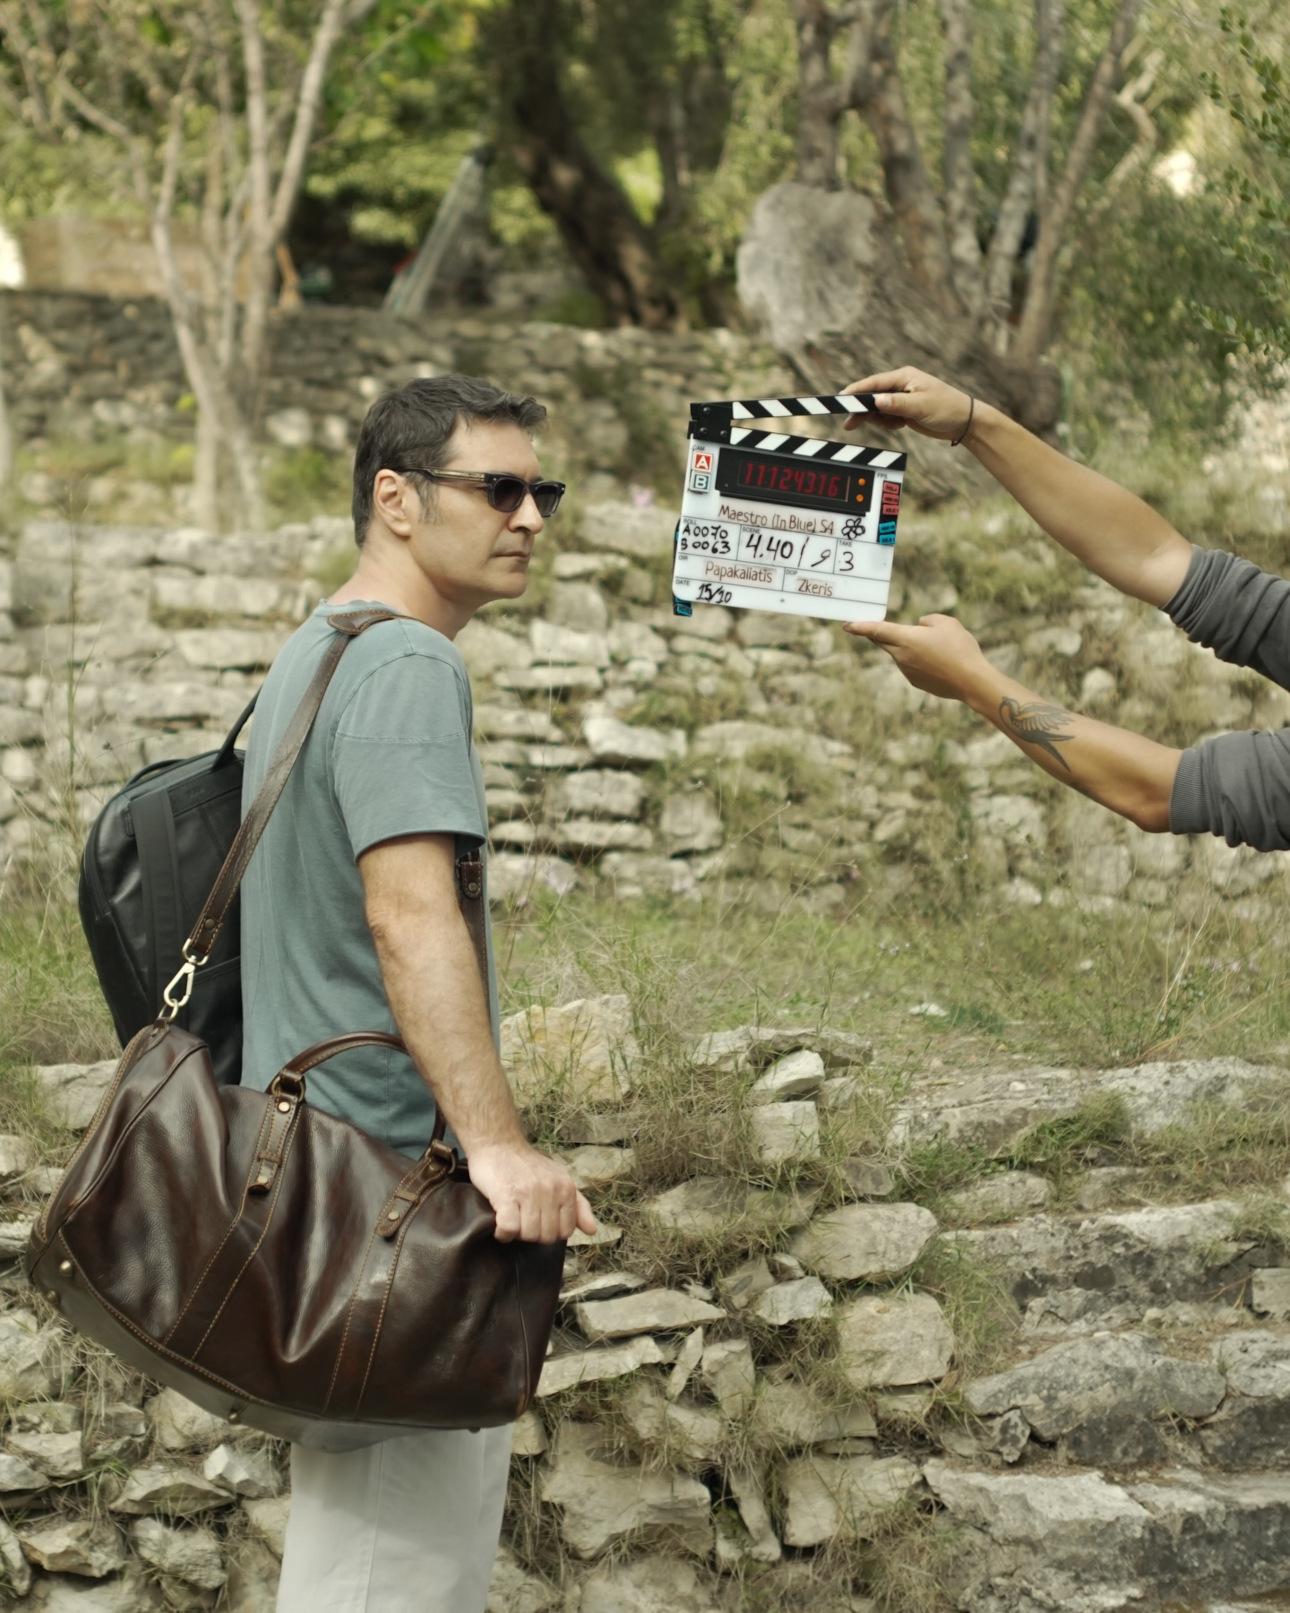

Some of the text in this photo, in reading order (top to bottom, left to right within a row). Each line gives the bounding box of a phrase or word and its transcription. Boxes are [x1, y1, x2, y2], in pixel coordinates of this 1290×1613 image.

[695, 454, 711, 470] A
[695, 475, 708, 489] B
[718, 504, 768, 526] Maestro
[704, 561, 773, 583] Papakaliatis
[839, 551, 854, 572] 3
[696, 583, 733, 604] 15/10
